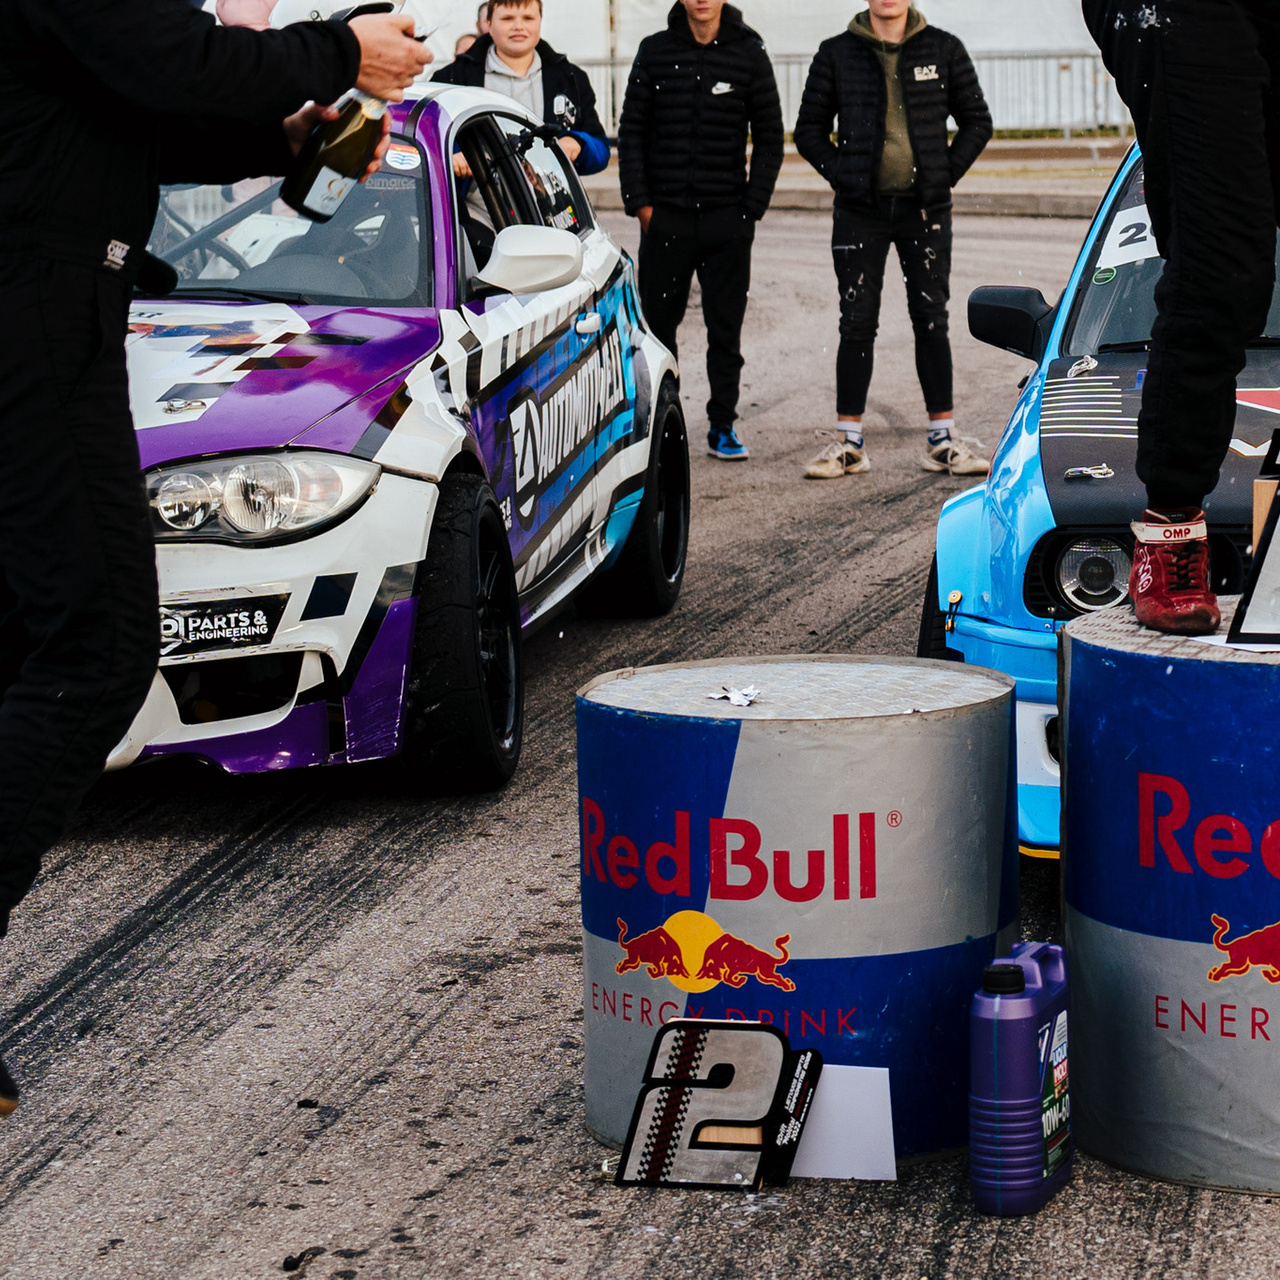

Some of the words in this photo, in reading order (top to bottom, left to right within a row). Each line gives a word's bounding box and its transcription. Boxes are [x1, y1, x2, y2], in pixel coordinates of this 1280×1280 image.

[1118, 222, 1156, 248] 2
[1163, 527, 1191, 539] OMP
[188, 612, 250, 631] PARTS
[253, 610, 268, 625] &
[189, 624, 268, 640] ENGINEERING
[582, 796, 691, 897] Red
[709, 812, 877, 903] Bull
[615, 1023, 789, 1190] 2
